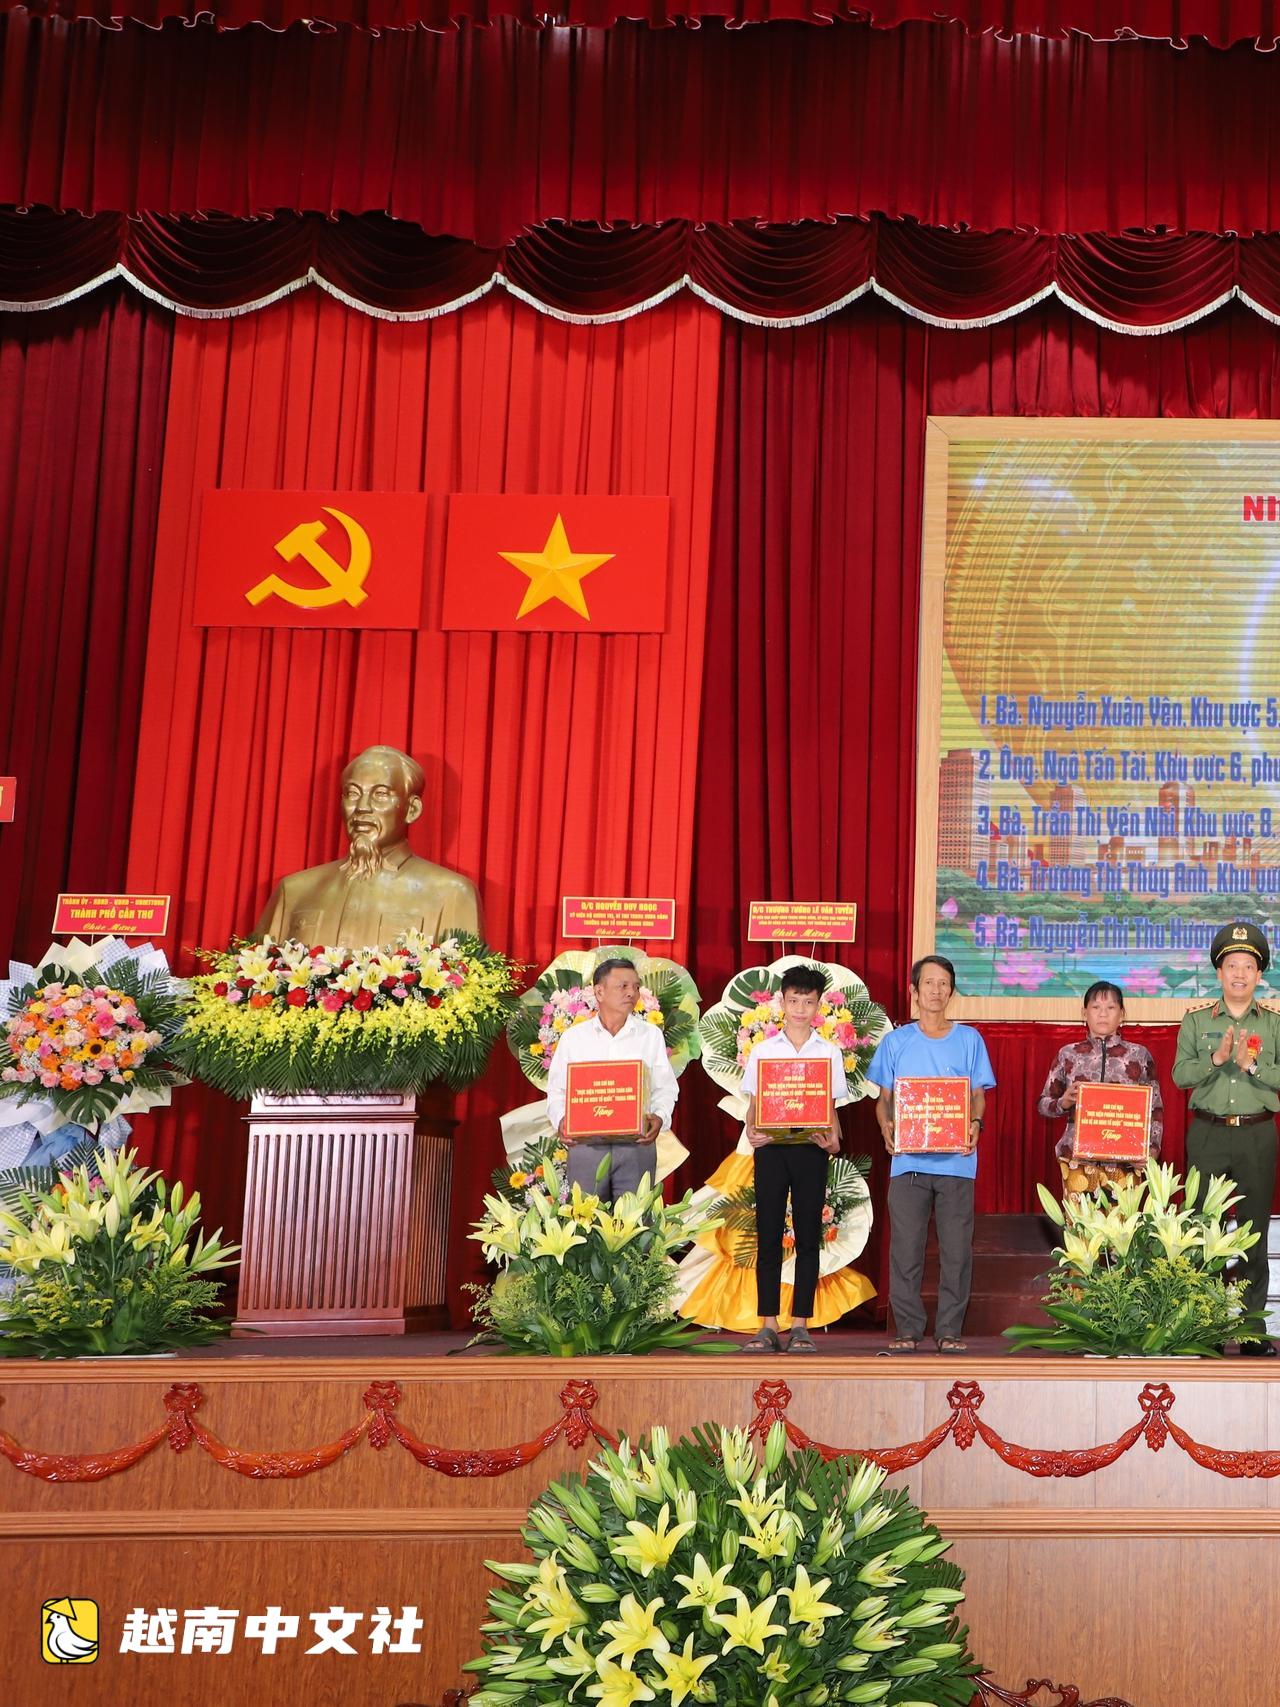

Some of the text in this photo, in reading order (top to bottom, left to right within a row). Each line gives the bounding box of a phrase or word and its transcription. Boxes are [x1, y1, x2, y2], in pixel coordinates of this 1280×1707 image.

[1028, 691, 1097, 731] Nguyễn
[1101, 695, 1143, 726] Xuân
[1191, 697, 1224, 727] Khu
[1229, 701, 1261, 734] vực
[1043, 750, 1079, 786] Ngô
[1085, 747, 1116, 781] Tấn
[1155, 751, 1188, 781] Khu
[1193, 754, 1225, 789] vực
[1032, 802, 1070, 836] Trần
[1075, 806, 1101, 844] Thị
[1106, 803, 1140, 836] Yến
[1184, 807, 1217, 837] Khu
[1223, 810, 1254, 845] vực
[1031, 861, 1091, 897] Trương
[1096, 862, 1122, 901] Thị
[1126, 861, 1169, 898] Thúy
[1217, 863, 1250, 893] Khu
